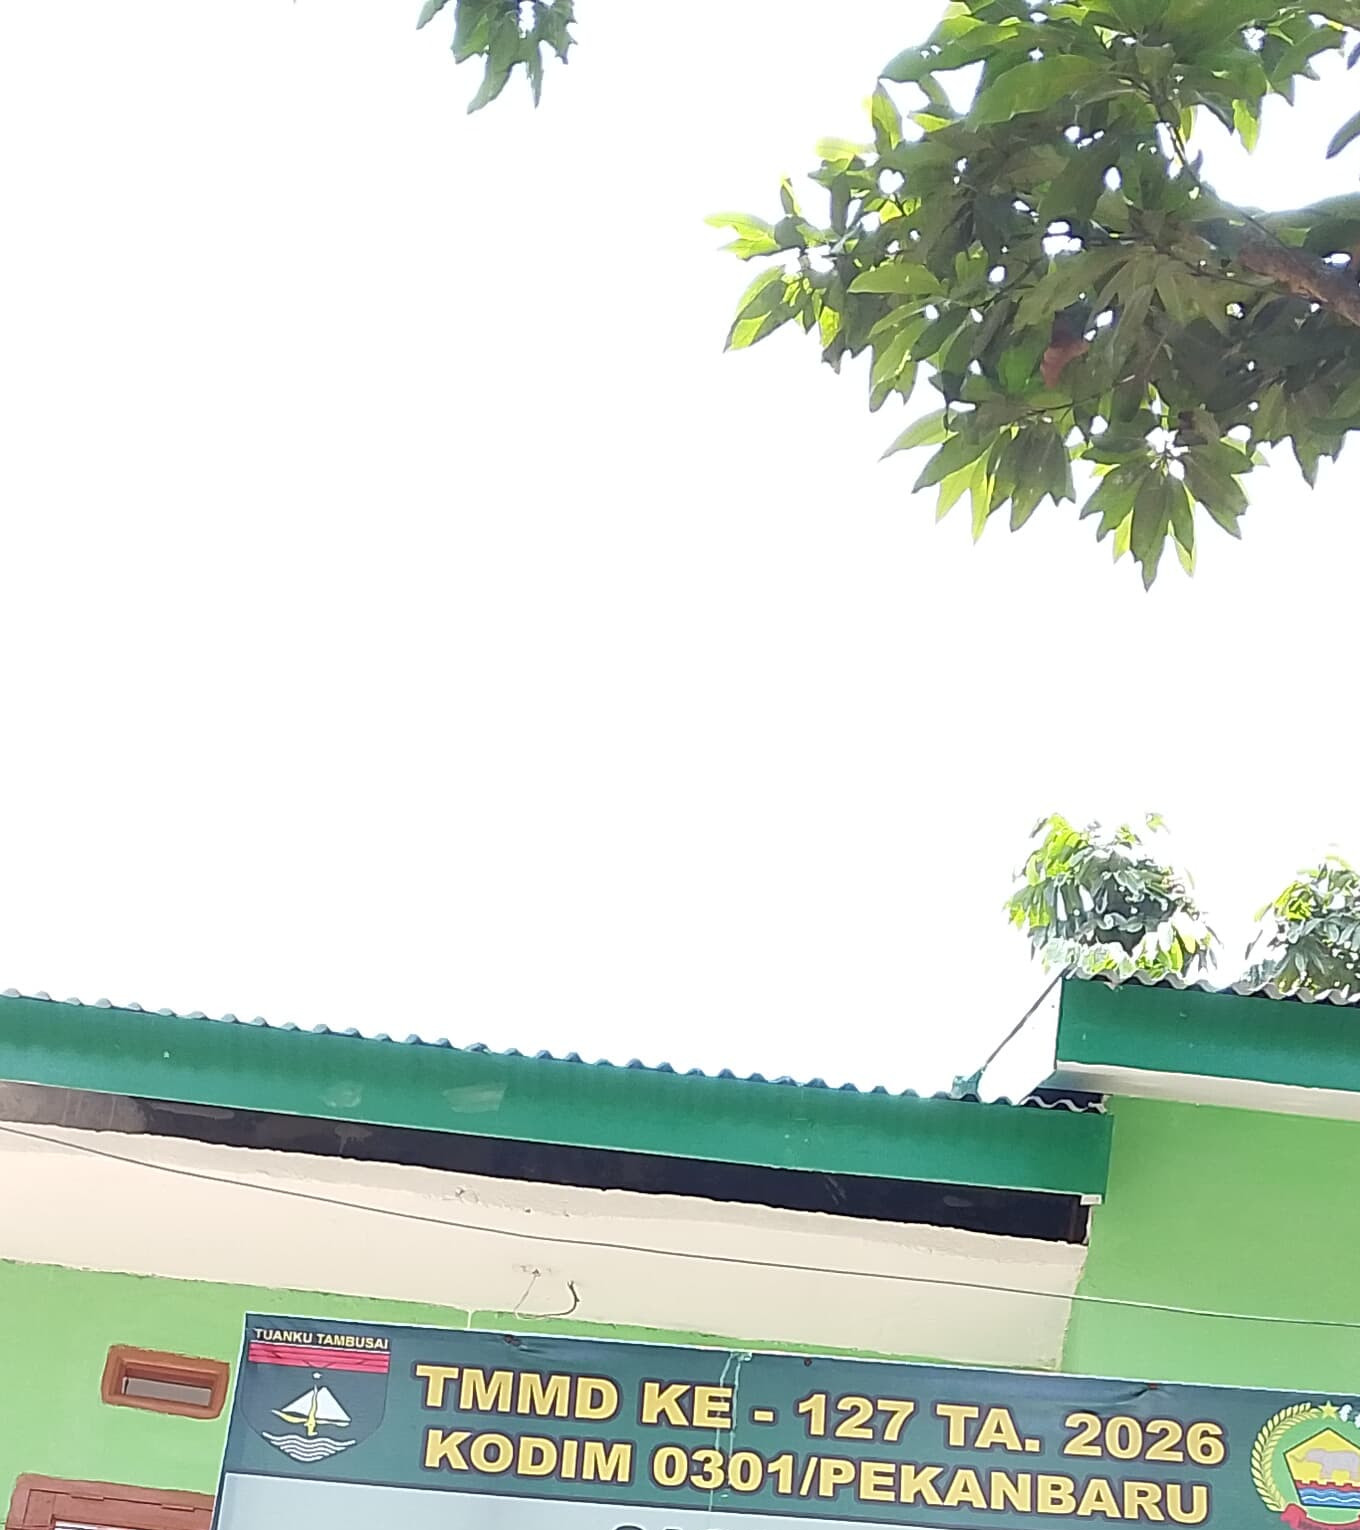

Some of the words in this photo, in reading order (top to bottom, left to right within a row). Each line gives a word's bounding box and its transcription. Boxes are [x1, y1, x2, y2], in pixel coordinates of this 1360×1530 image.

[253, 1328, 312, 1343] TUANKU
[316, 1333, 388, 1349] TAMBUSAI
[416, 1364, 619, 1419] TMMD
[641, 1383, 733, 1429] KE
[753, 1408, 774, 1421] -
[798, 1395, 912, 1442] 127
[937, 1404, 1040, 1451] TA.
[1064, 1414, 1226, 1464] 2026
[424, 1430, 631, 1482] KODIM
[653, 1446, 1209, 1524] 0301/PEKANBARU
